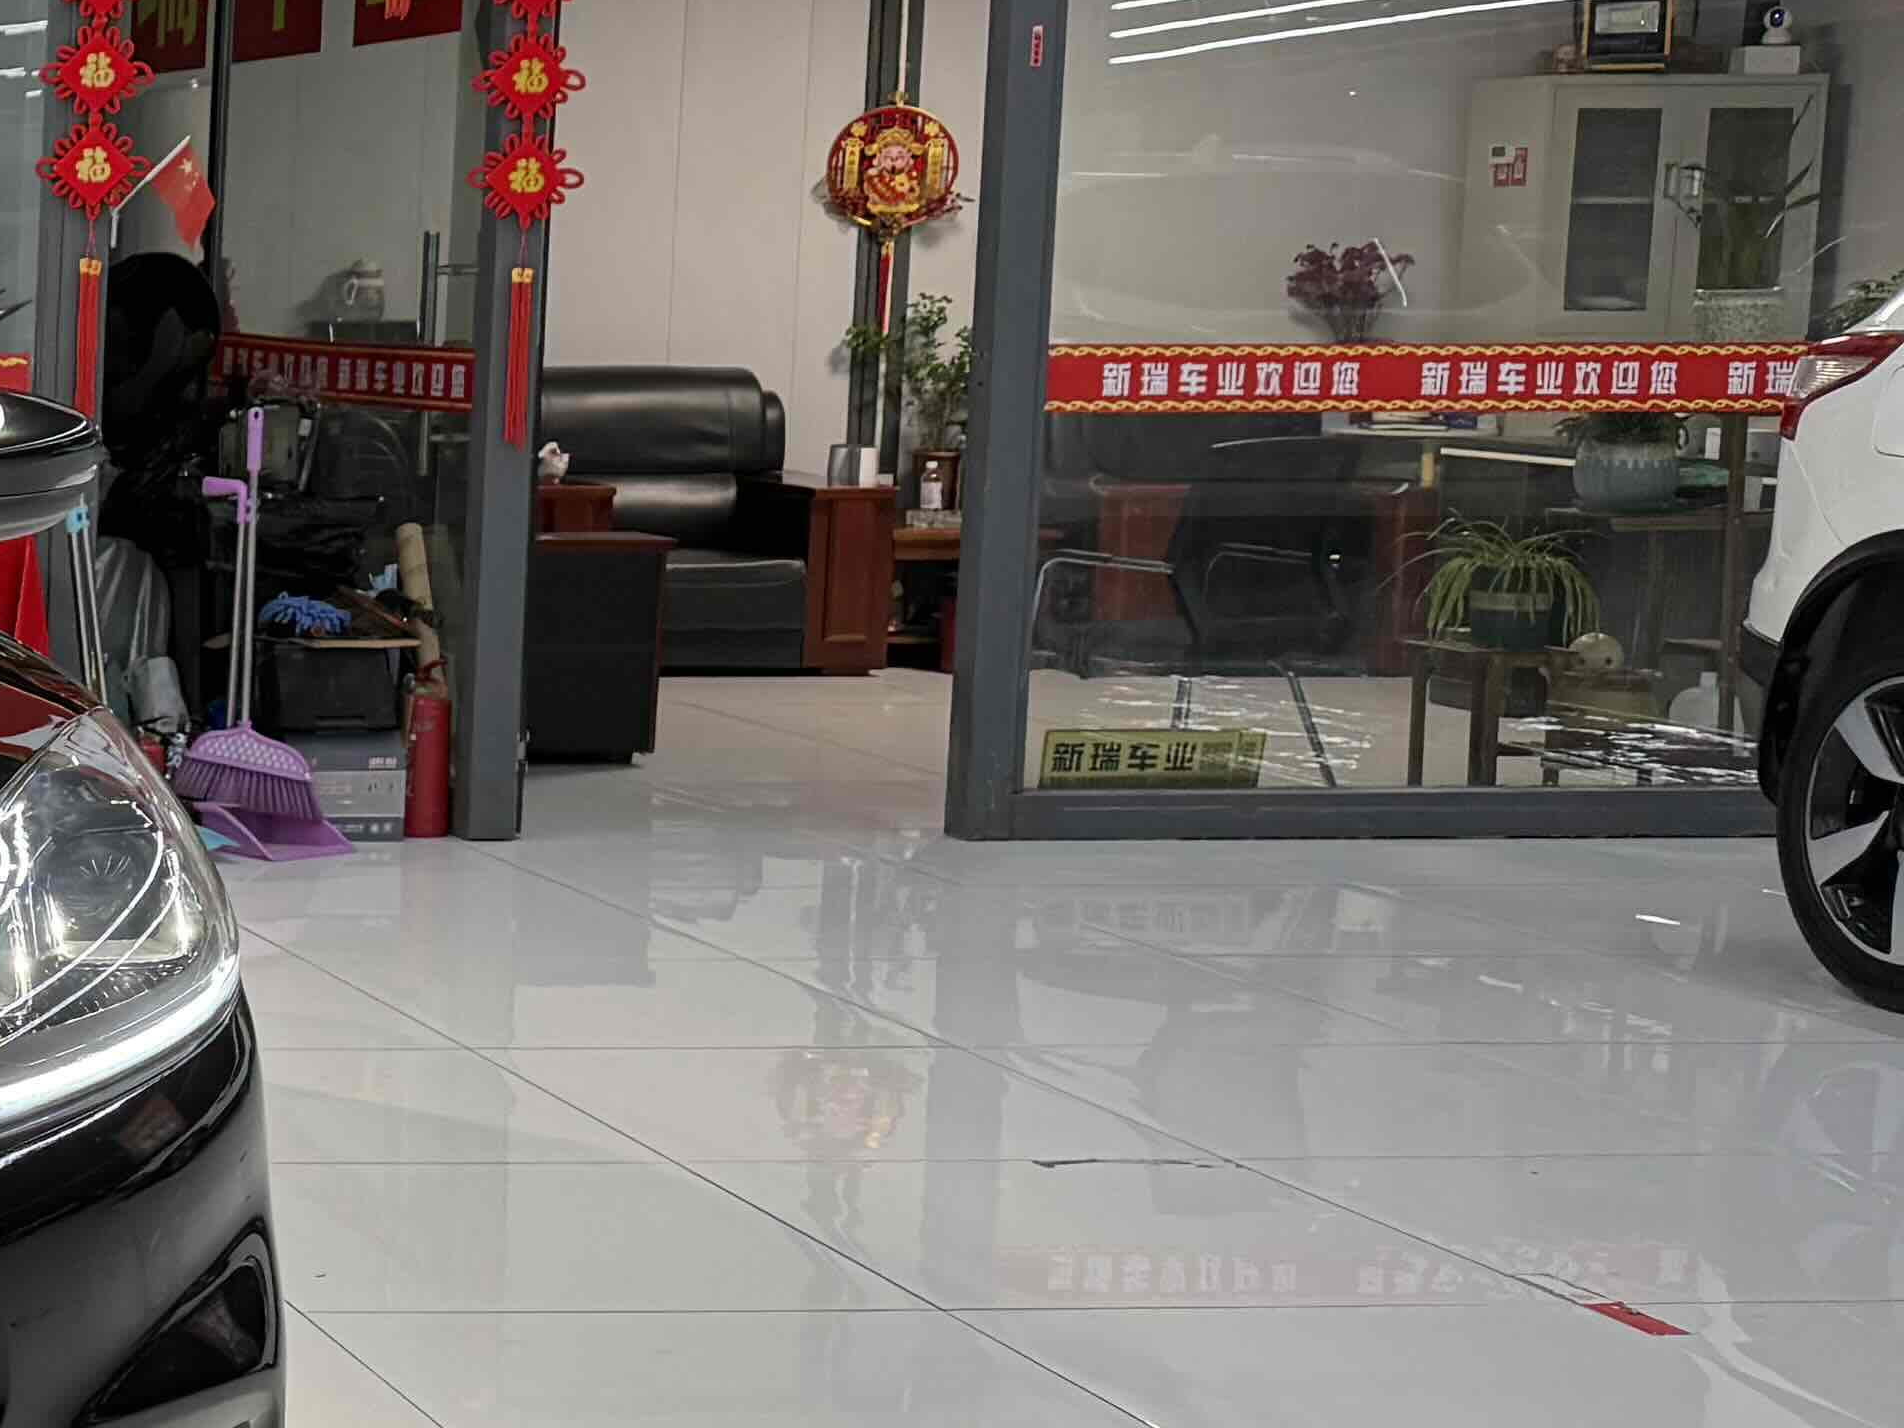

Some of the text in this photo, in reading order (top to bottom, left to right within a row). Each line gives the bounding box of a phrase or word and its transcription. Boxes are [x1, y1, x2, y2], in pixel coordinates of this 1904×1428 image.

[79, 51, 116, 89] 福
[513, 59, 549, 95] 福
[76, 148, 112, 184] 福
[508, 156, 546, 193] 福
[1101, 360, 1361, 398] 新瑞车业欢迎您
[1420, 360, 1679, 397] 新瑞车业欢迎您
